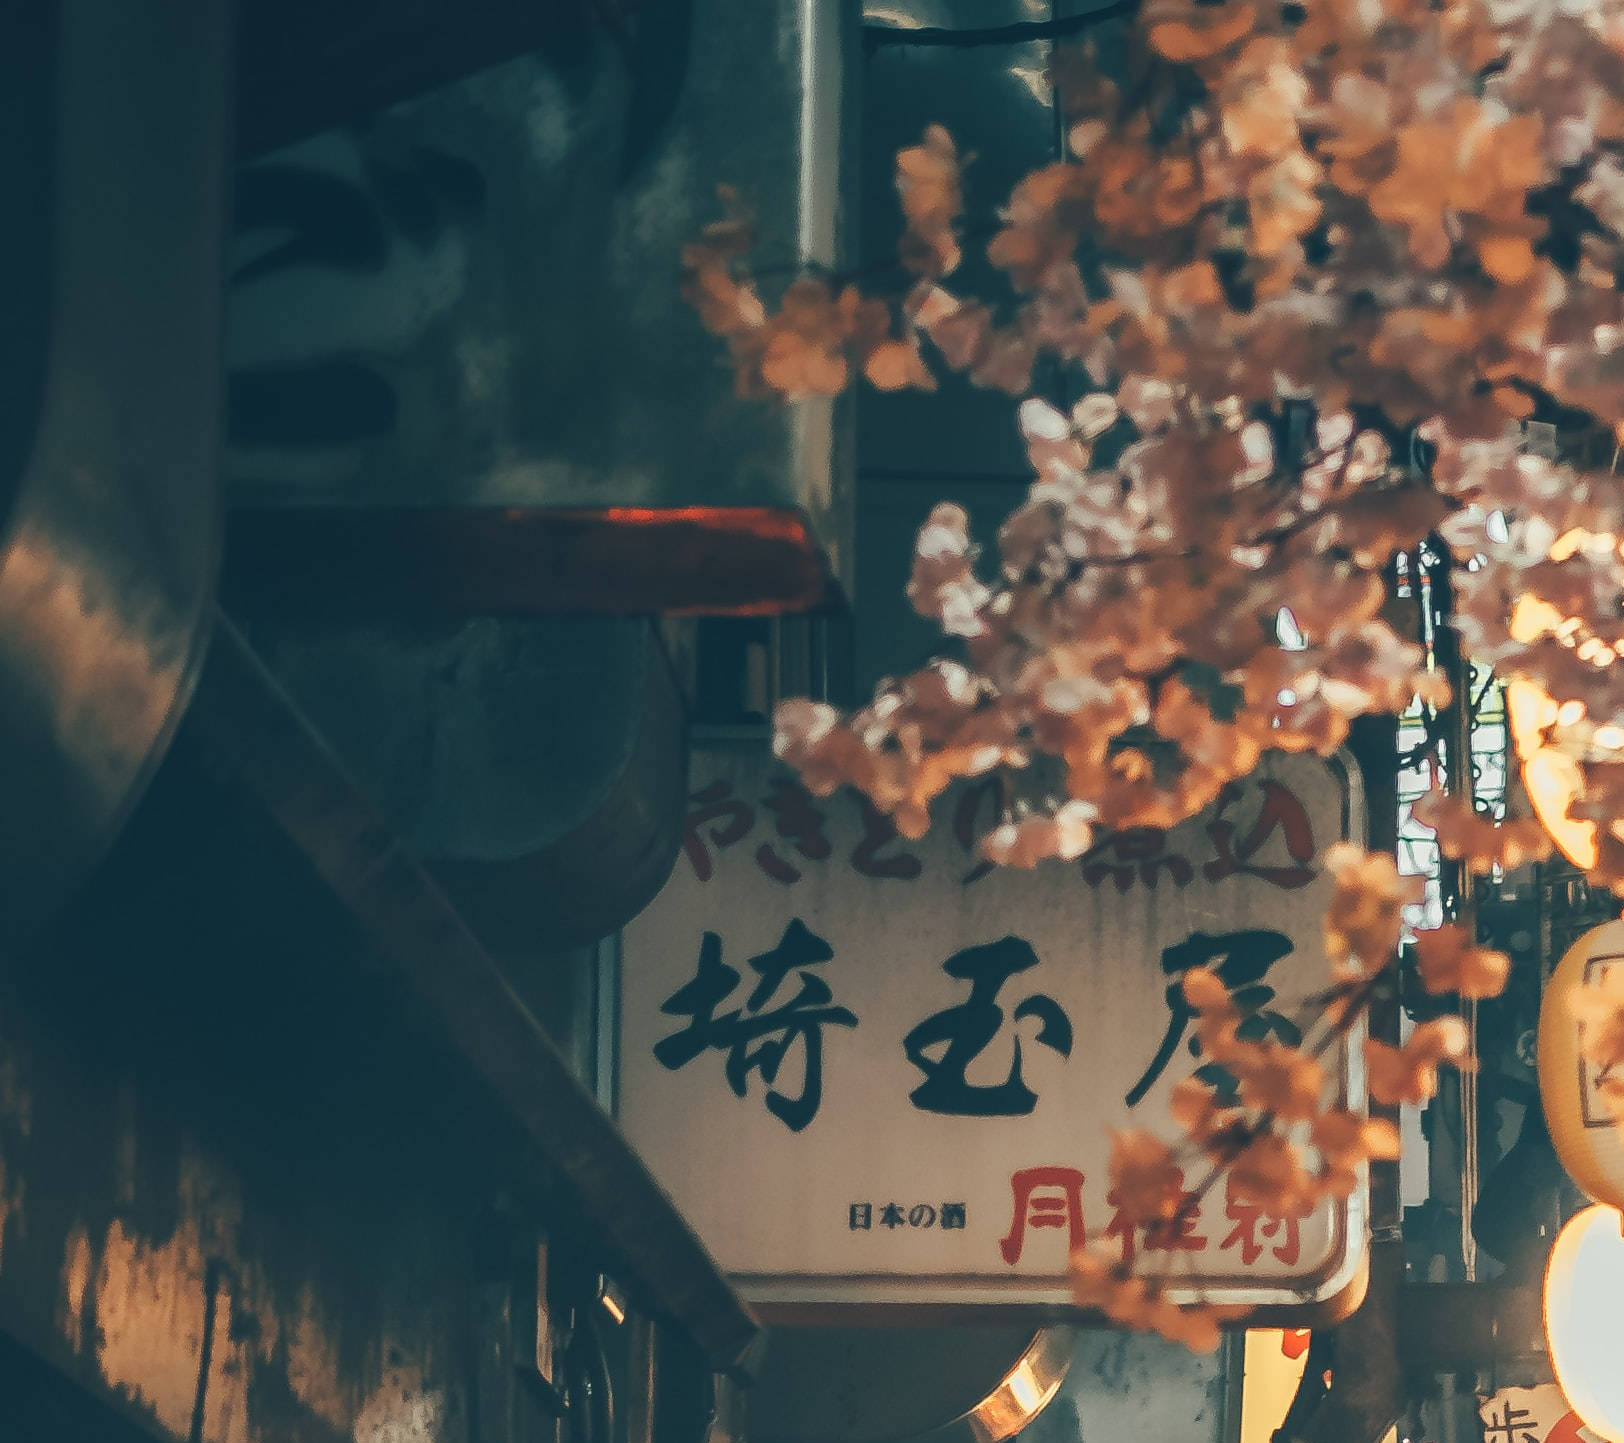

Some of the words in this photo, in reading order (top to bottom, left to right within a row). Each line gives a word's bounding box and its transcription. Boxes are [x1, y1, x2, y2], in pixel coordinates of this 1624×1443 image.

[653, 917, 1297, 1132] 埼玉屋
[848, 1202, 967, 1232] 日本の酒
